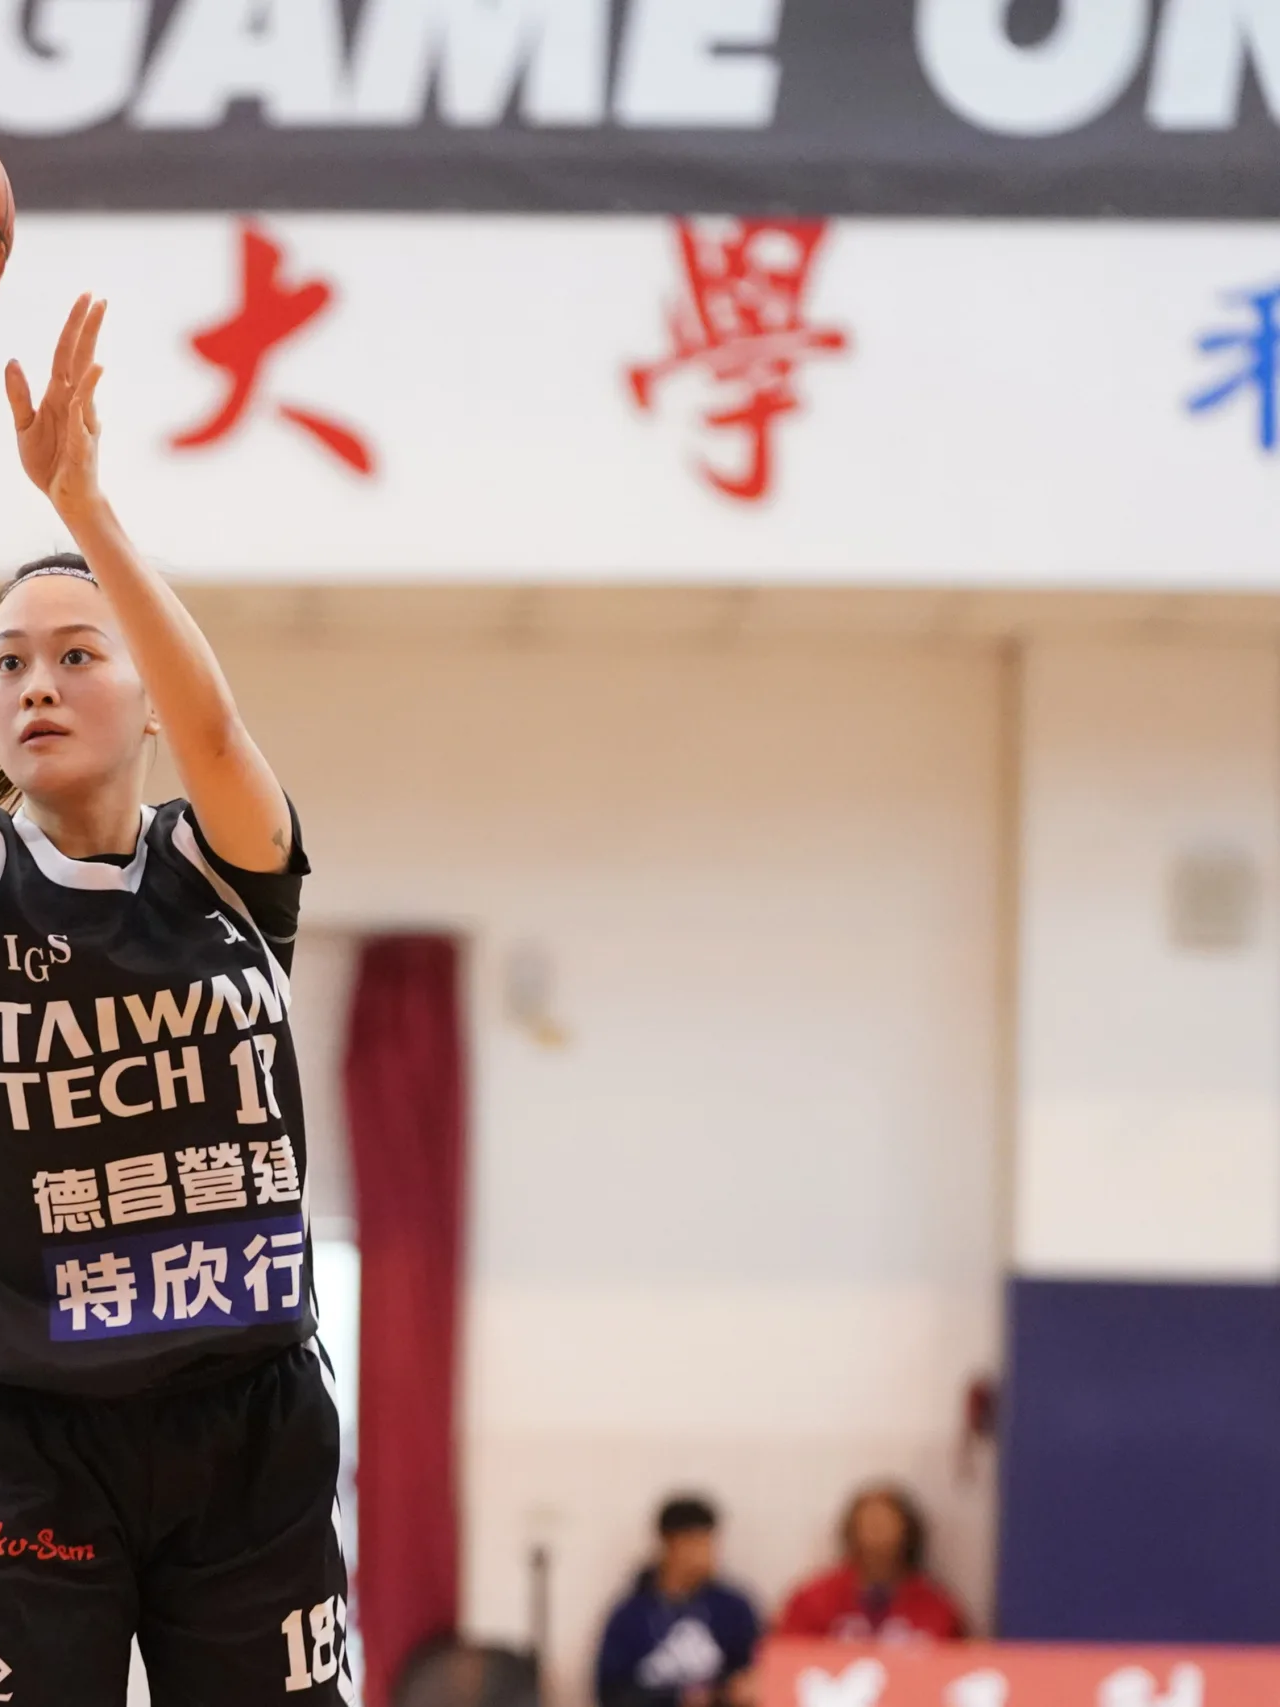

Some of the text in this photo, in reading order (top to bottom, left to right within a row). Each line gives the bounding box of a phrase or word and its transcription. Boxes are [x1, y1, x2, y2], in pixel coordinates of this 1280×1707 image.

[3, 933, 72, 984] IGS
[31, 1134, 302, 1234] 德昌營建
[55, 1230, 304, 1331] 特欣行
[280, 1595, 336, 1693] 18
